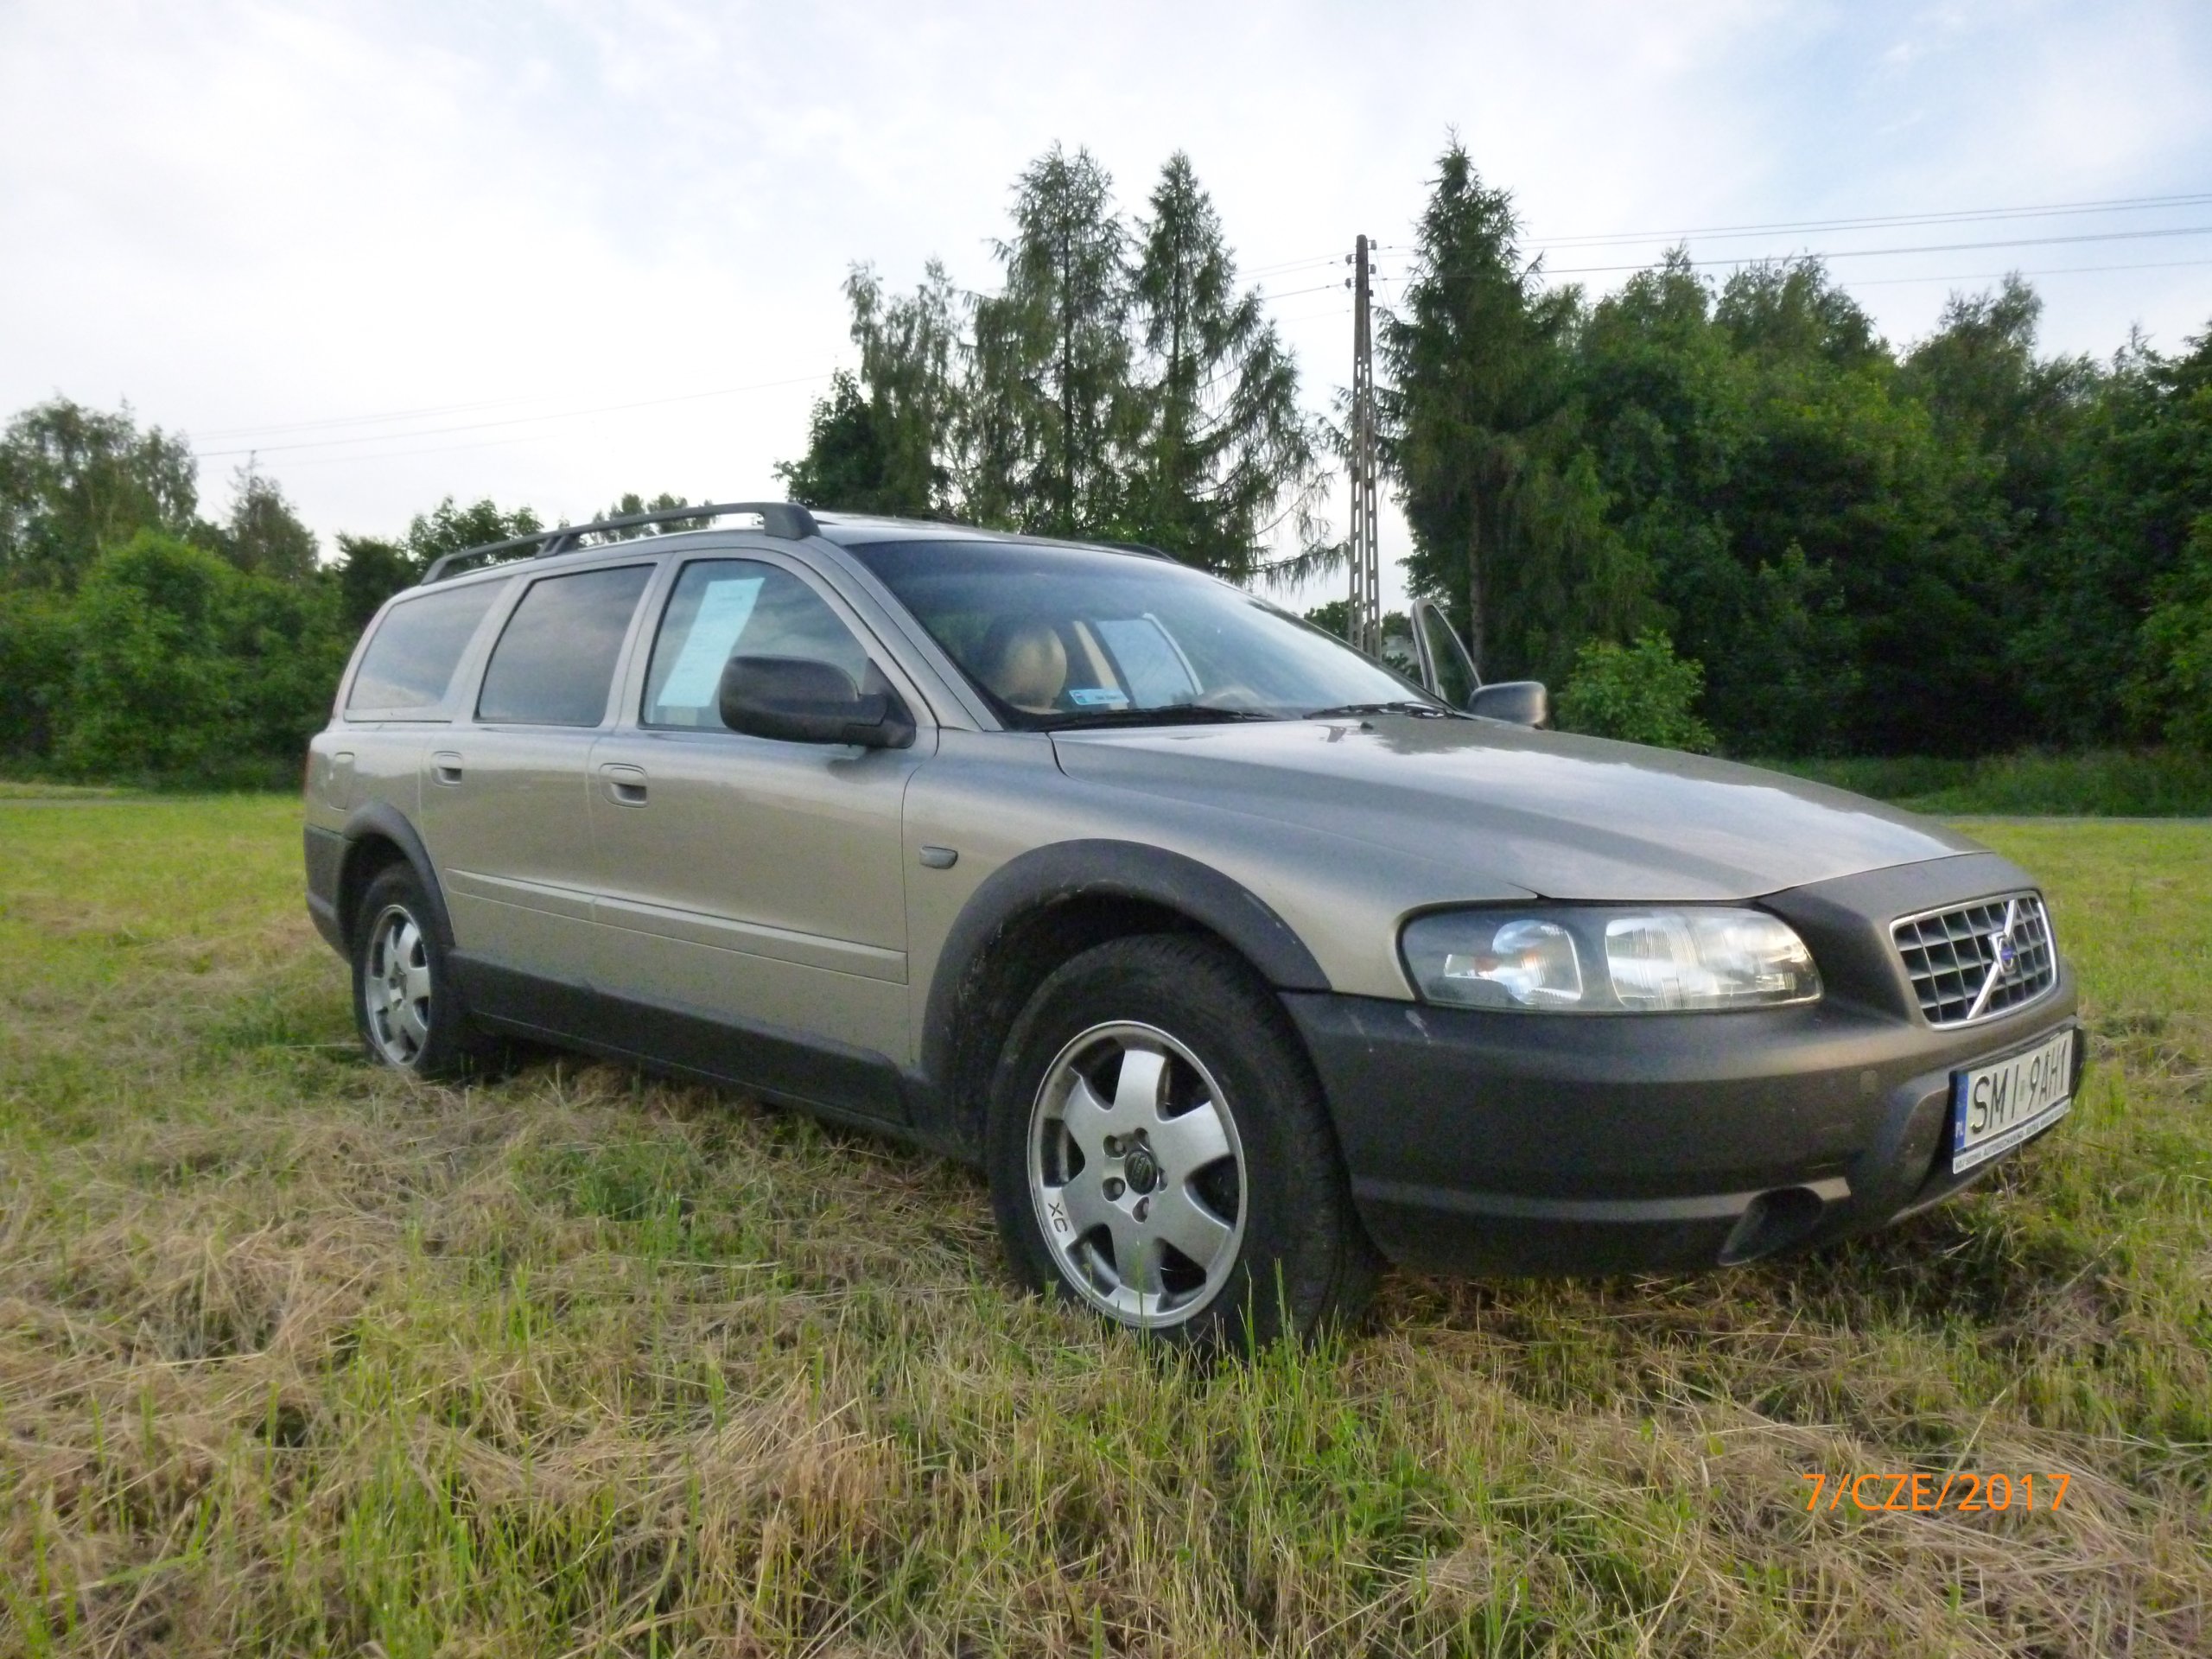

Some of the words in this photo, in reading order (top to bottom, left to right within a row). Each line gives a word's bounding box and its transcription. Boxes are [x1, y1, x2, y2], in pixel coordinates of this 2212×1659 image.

[1971, 1064, 2019, 1134] SMI
[2027, 1038, 2068, 1111] 9AH1
[1955, 1121, 1964, 1138] PL
[1047, 1202, 1068, 1234] XC
